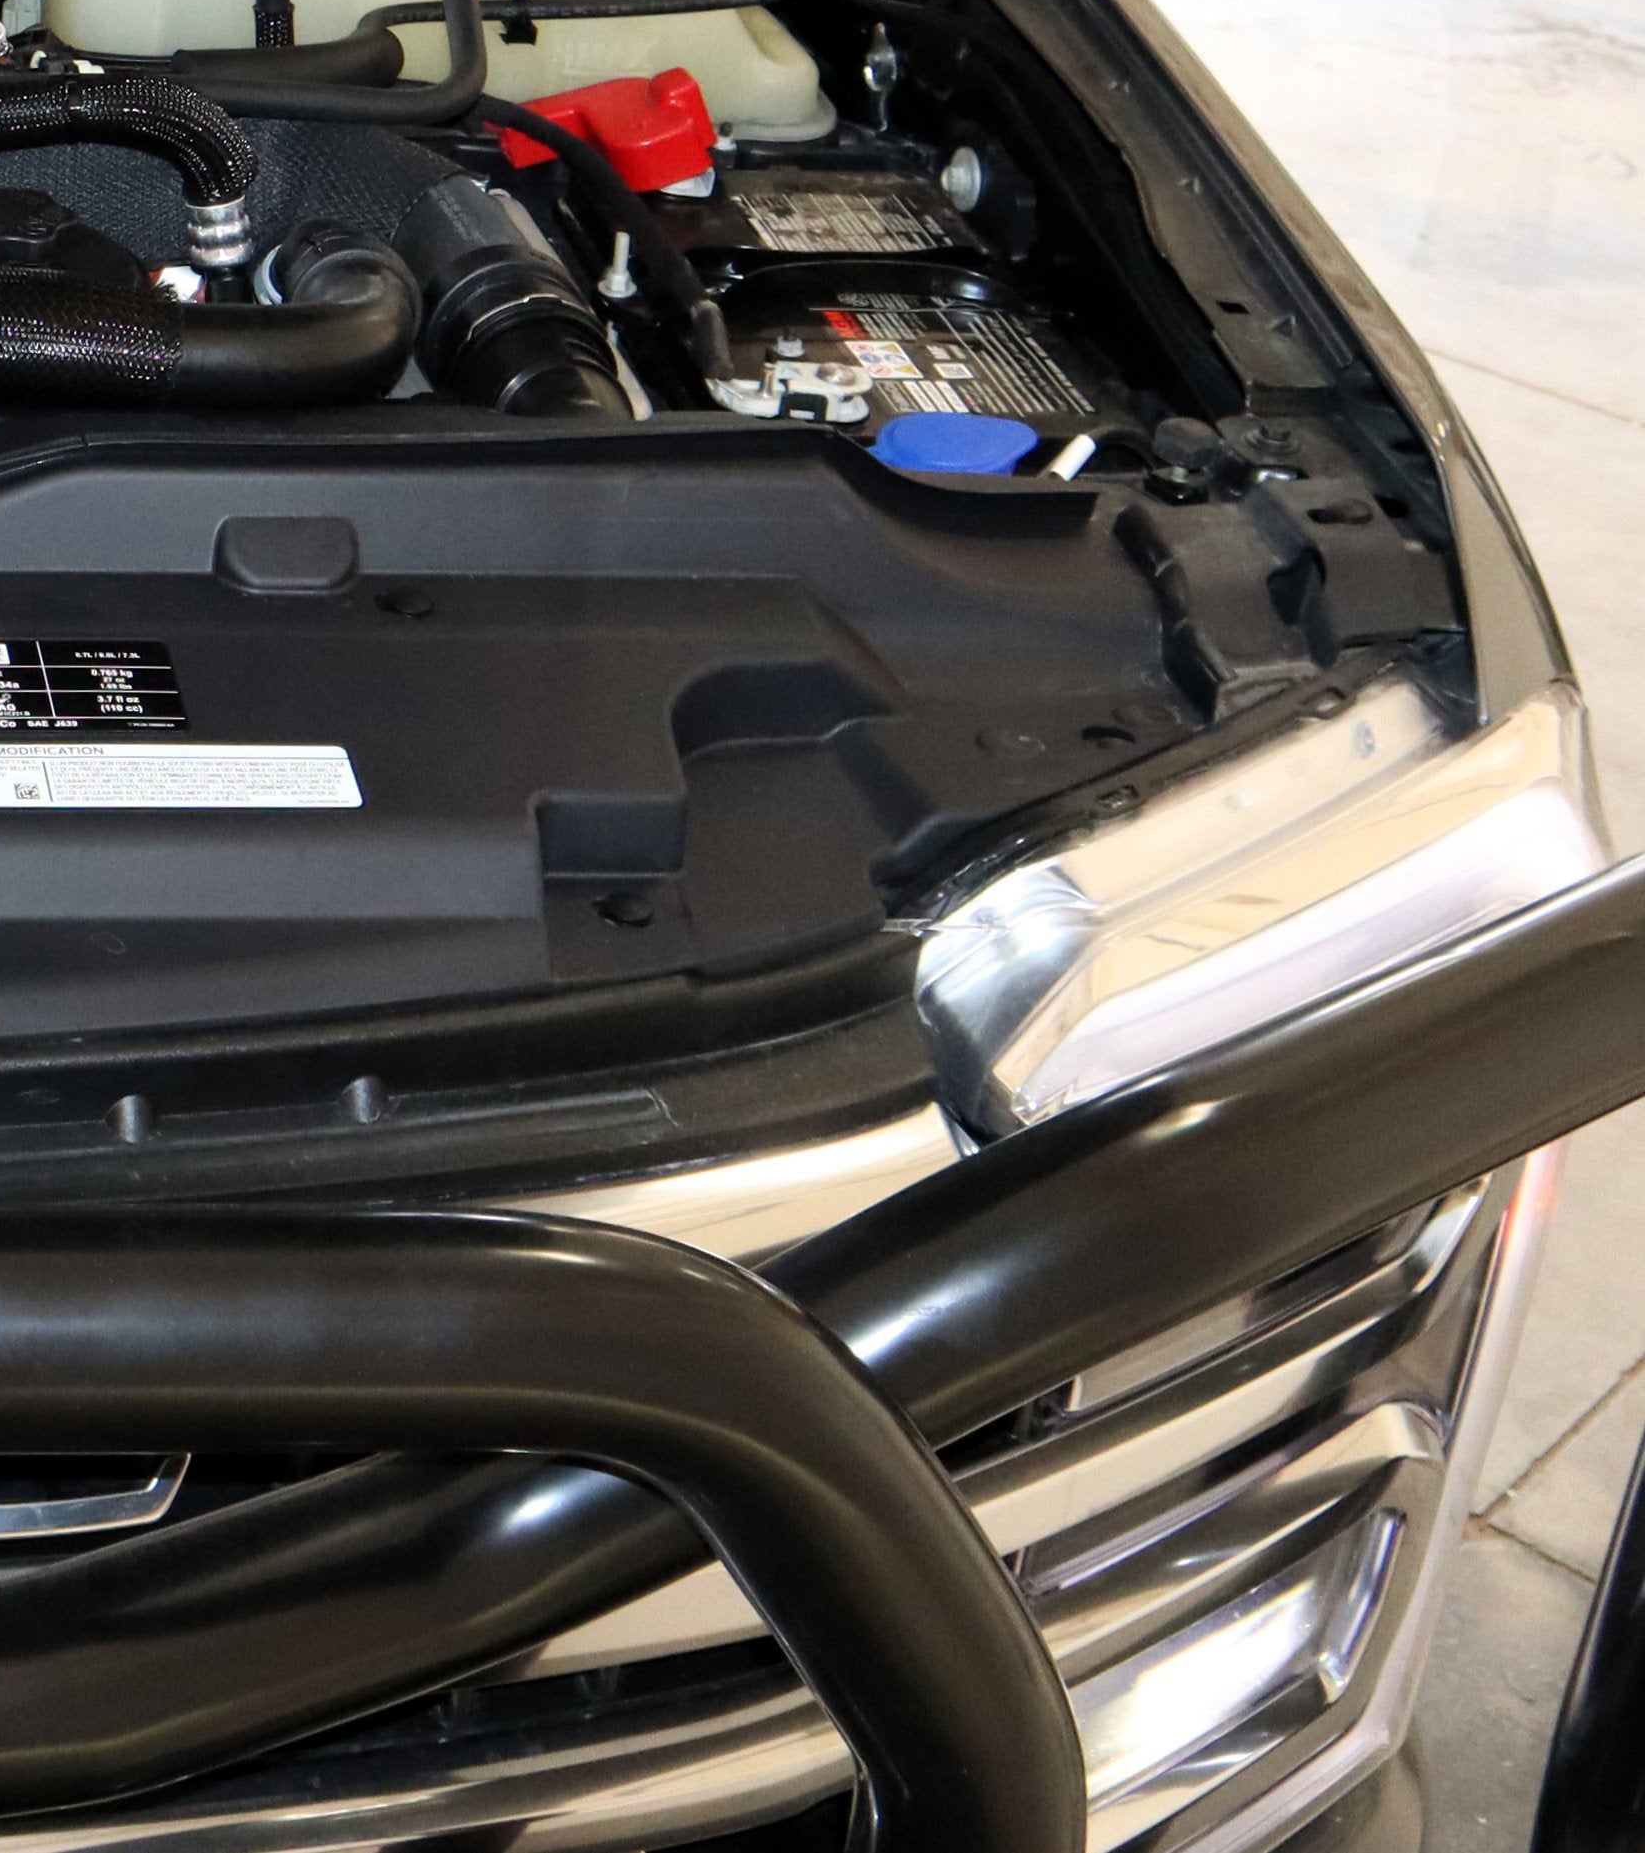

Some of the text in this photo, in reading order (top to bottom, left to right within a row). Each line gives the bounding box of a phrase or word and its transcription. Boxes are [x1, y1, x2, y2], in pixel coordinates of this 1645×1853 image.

[119, 669, 134, 678] kg
[97, 695, 112, 703] 3.7
[115, 695, 124, 703] fl
[100, 704, 143, 713] (110 cc)
